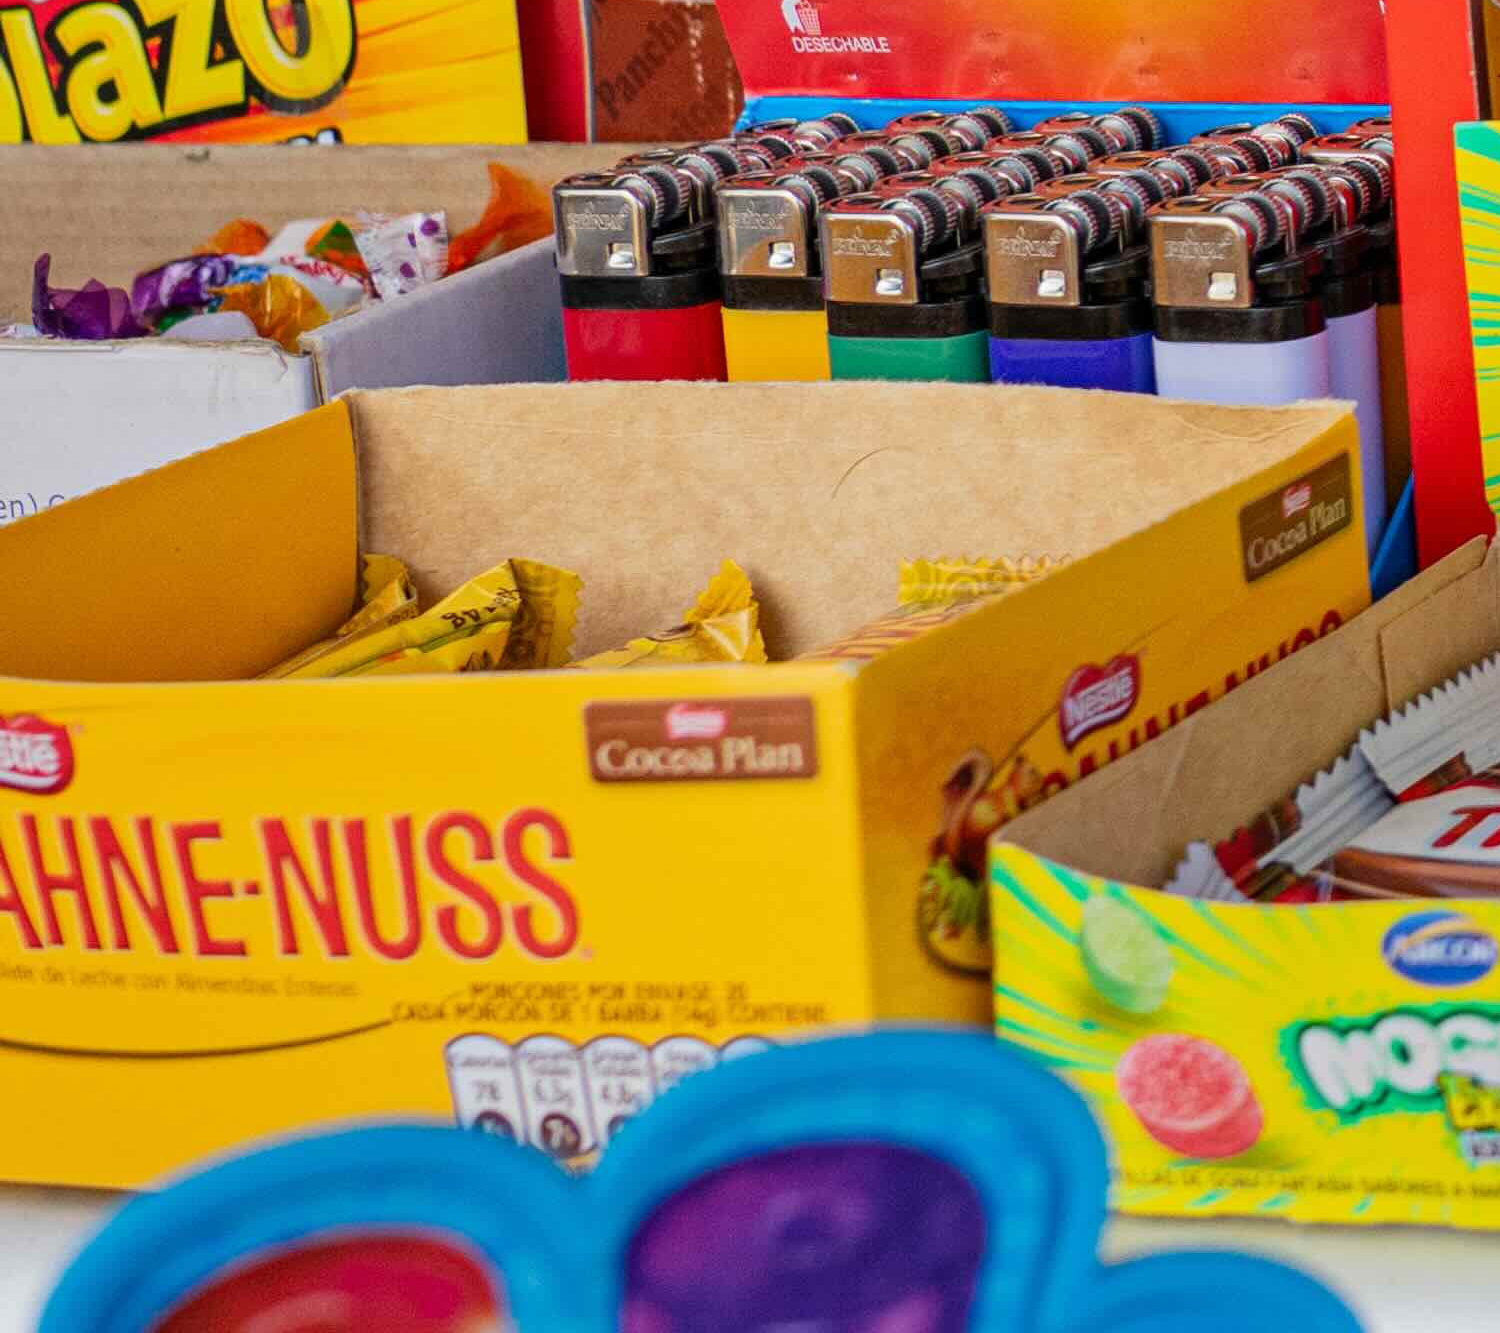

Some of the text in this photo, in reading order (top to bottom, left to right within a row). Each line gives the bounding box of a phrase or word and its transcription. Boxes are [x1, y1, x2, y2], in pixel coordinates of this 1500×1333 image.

[792, 36, 891, 54] DESECHABLE
[595, 735, 803, 777] Cocoa Plan
